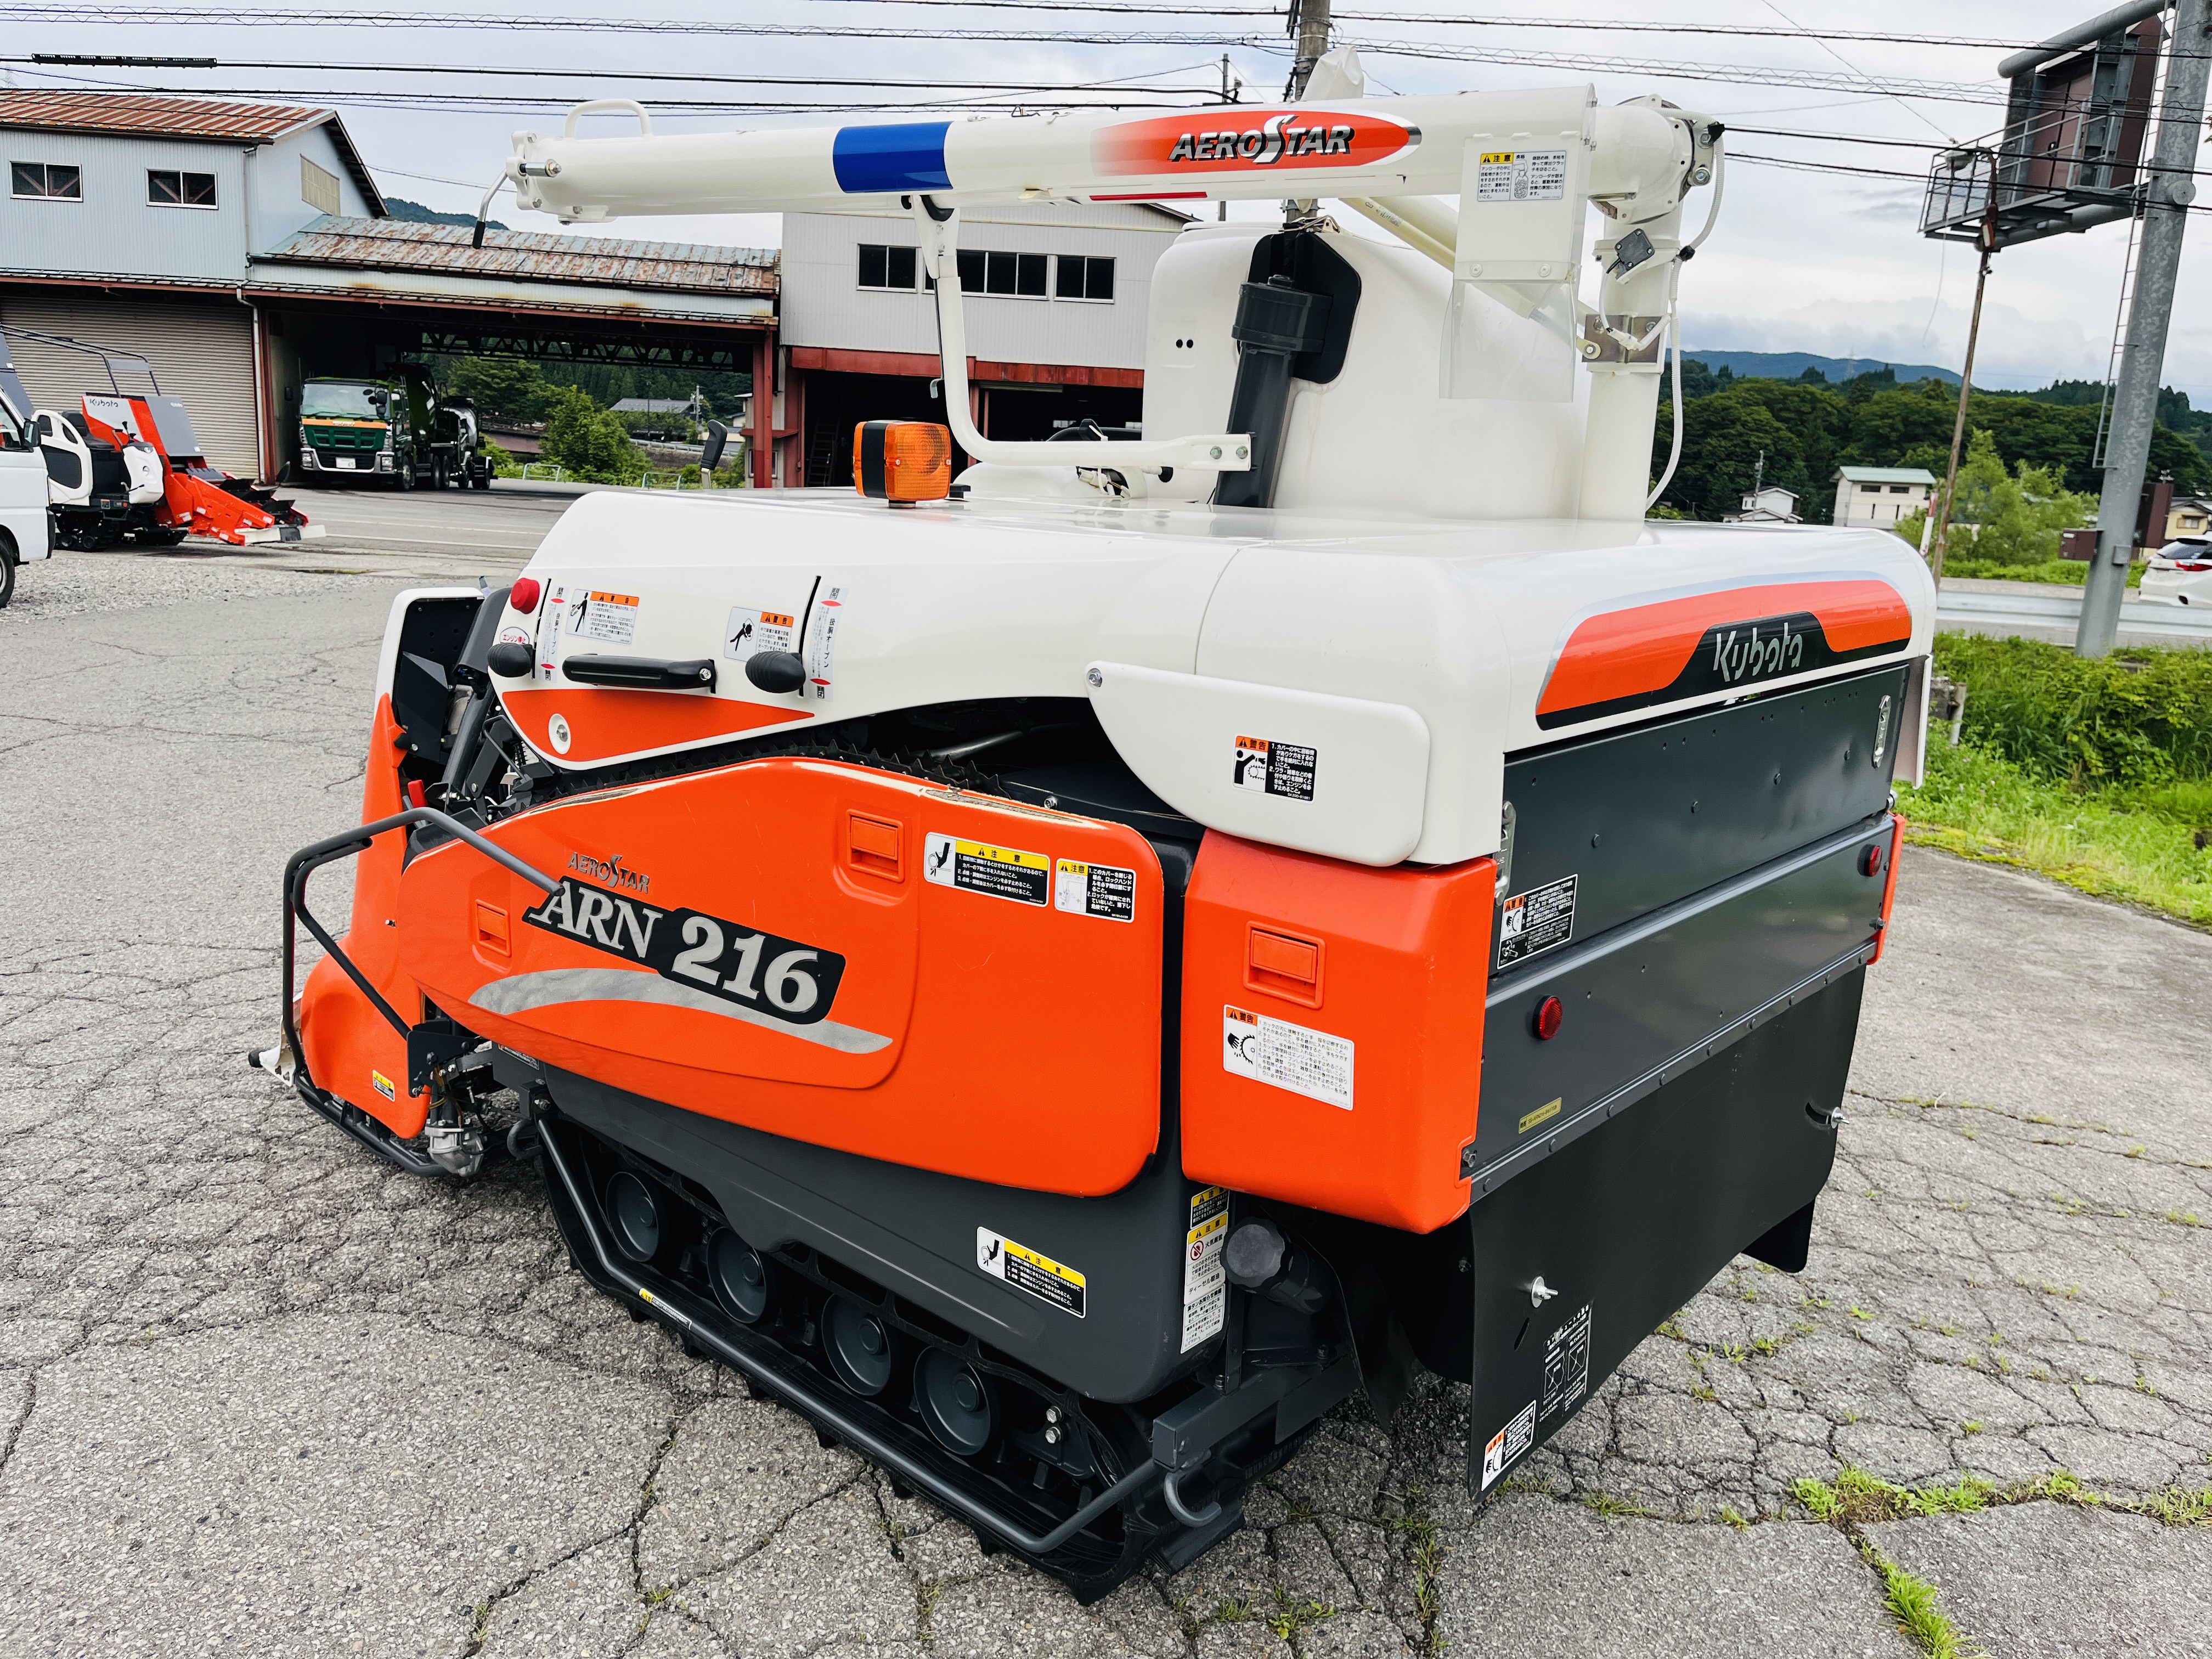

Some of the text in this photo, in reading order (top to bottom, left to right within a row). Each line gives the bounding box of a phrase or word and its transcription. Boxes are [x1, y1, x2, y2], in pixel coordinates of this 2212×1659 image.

[1167, 114, 1355, 165] AEROSTAR
[1493, 154, 1511, 162] 注意
[90, 398, 119, 407] Kubota
[1713, 622, 1803, 682] Kubota
[1249, 739, 1266, 751] 警告
[991, 849, 1020, 863] 注意
[567, 852, 650, 894] AEROSTAR
[1070, 864, 1085, 873] 注意
[528, 880, 819, 1013] ARN 216
[1239, 1012, 1254, 1024] 警告
[1205, 1218, 1220, 1233] 注意
[1188, 1272, 1220, 1295] ディーゼル軽油
